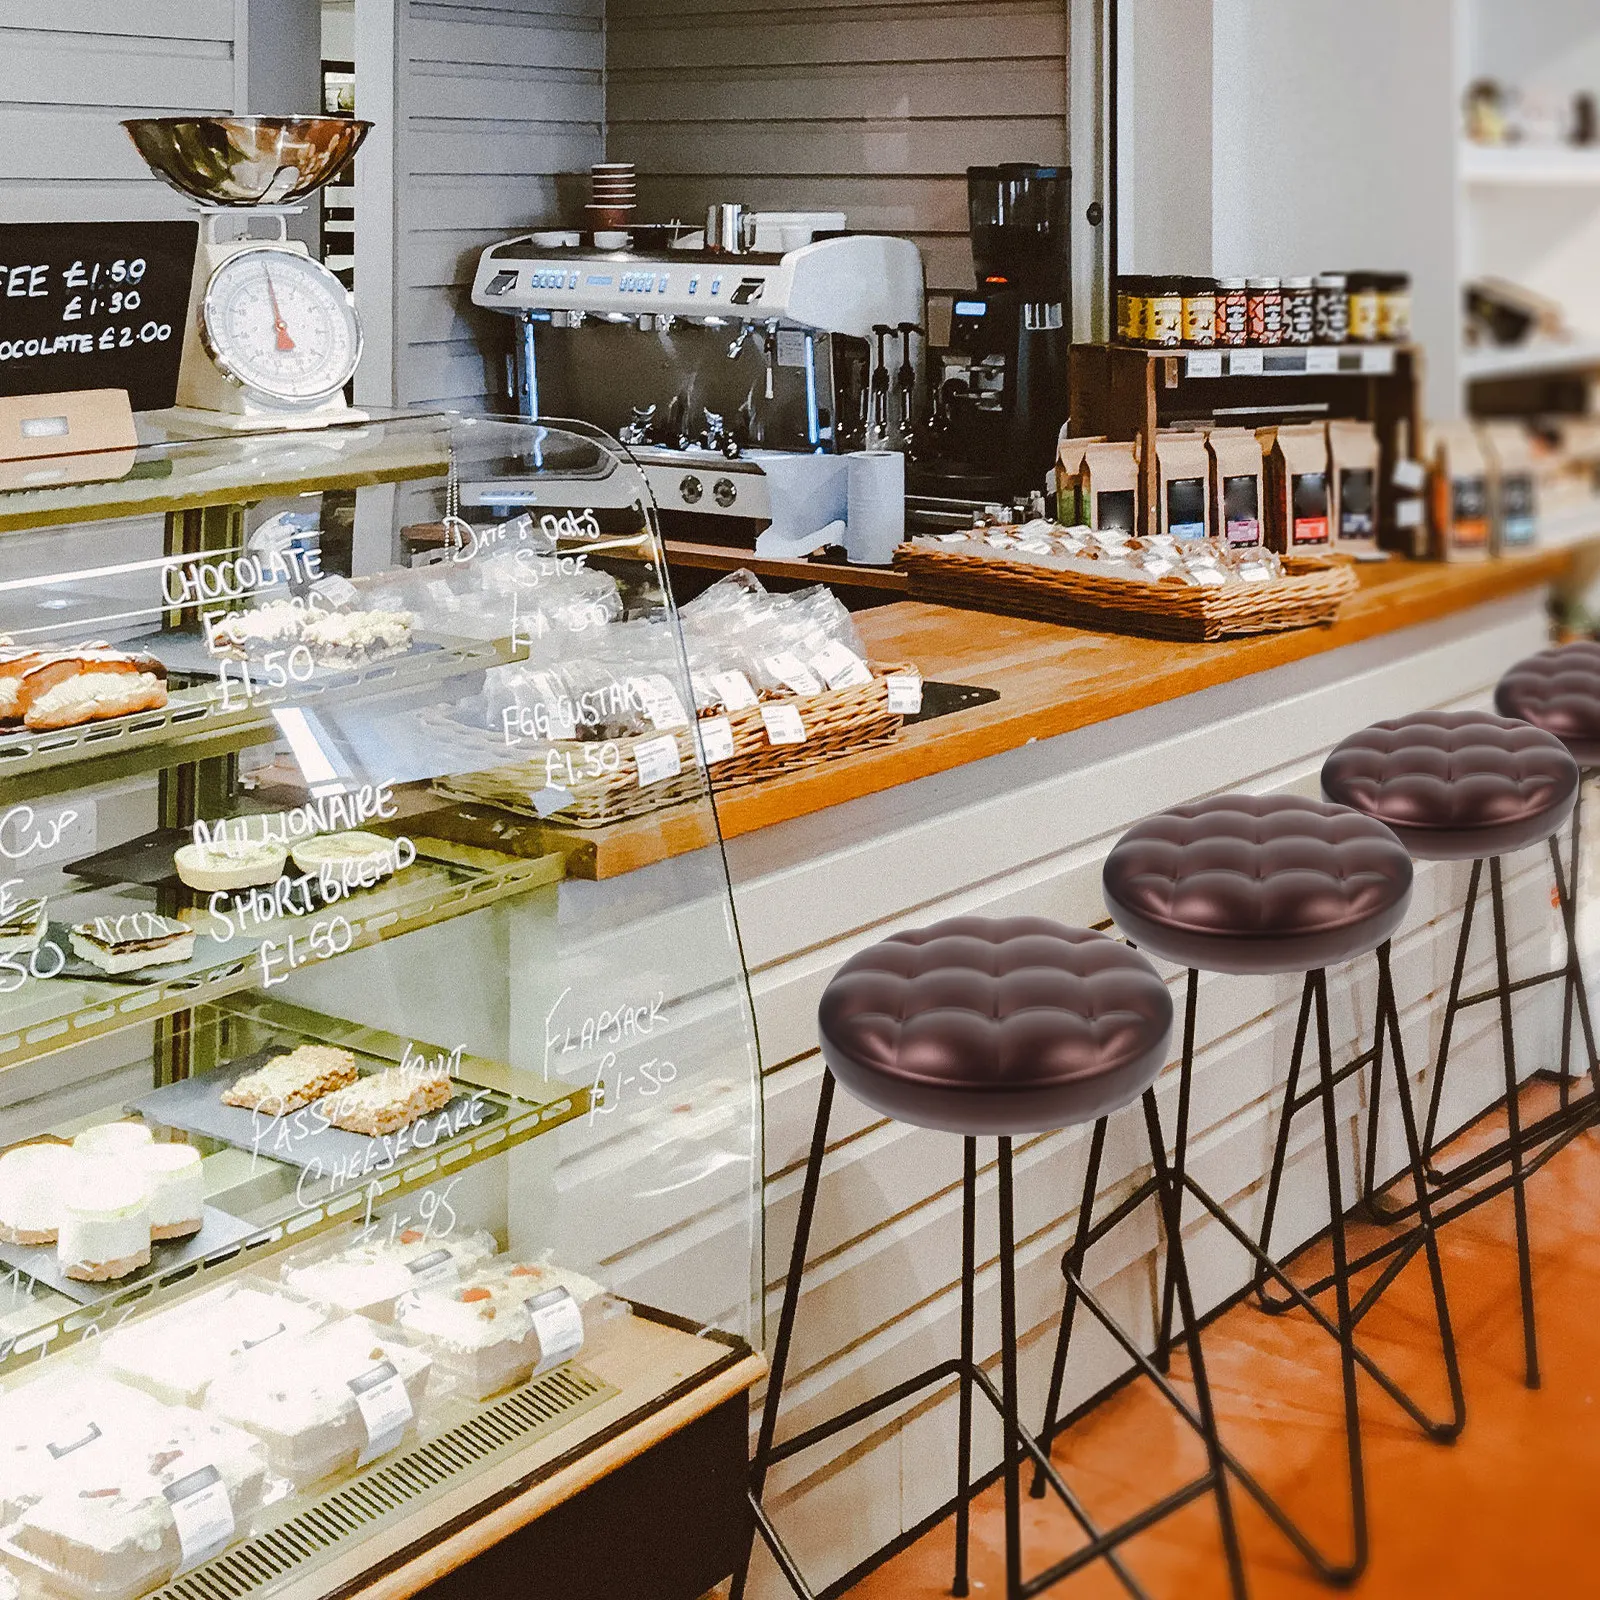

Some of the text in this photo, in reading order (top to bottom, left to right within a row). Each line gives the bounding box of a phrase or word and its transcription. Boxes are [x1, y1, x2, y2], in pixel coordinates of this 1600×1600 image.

[161, 548, 325, 606] CHOCOLATE
[502, 703, 555, 746] EGG
[208, 836, 416, 943] SHORTBREAD
[544, 986, 670, 1083] FLAPJACK
[296, 1089, 492, 1209] CHEESECAKE
